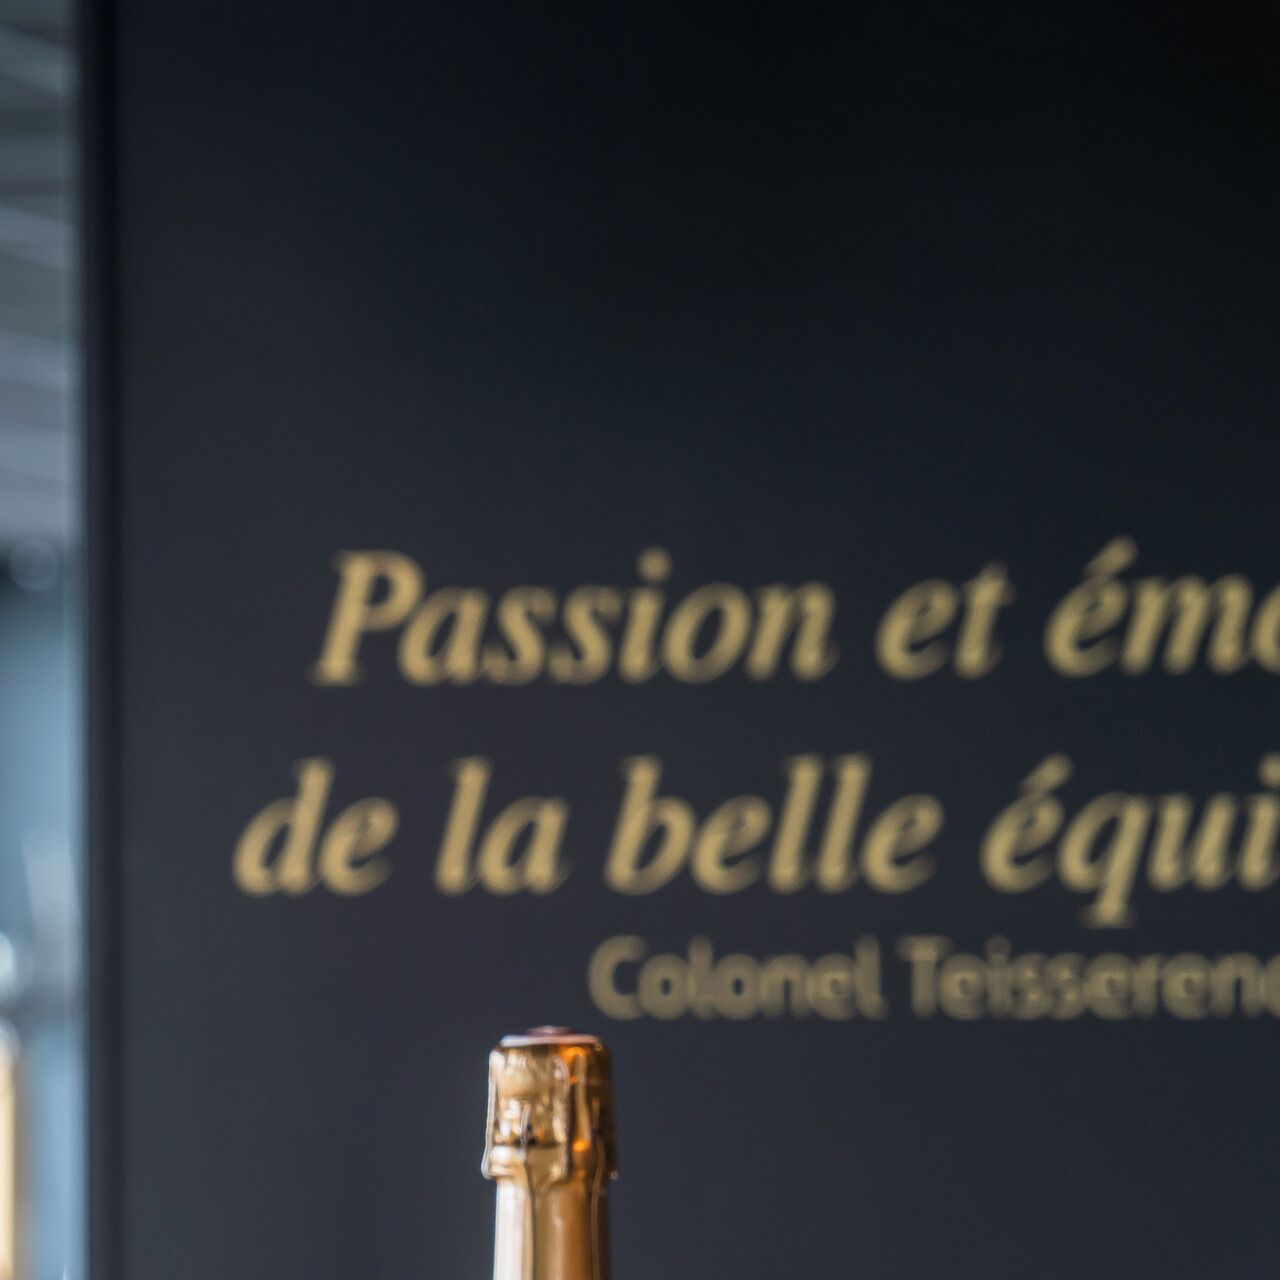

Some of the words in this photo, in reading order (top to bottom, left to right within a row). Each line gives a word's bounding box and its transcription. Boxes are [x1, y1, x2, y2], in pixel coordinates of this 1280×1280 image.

[312, 545, 835, 686] Passion
[874, 562, 1010, 680] et
[232, 755, 398, 896] de
[434, 755, 568, 896] la
[604, 752, 946, 896] belle
[587, 934, 886, 1021] Colonel
